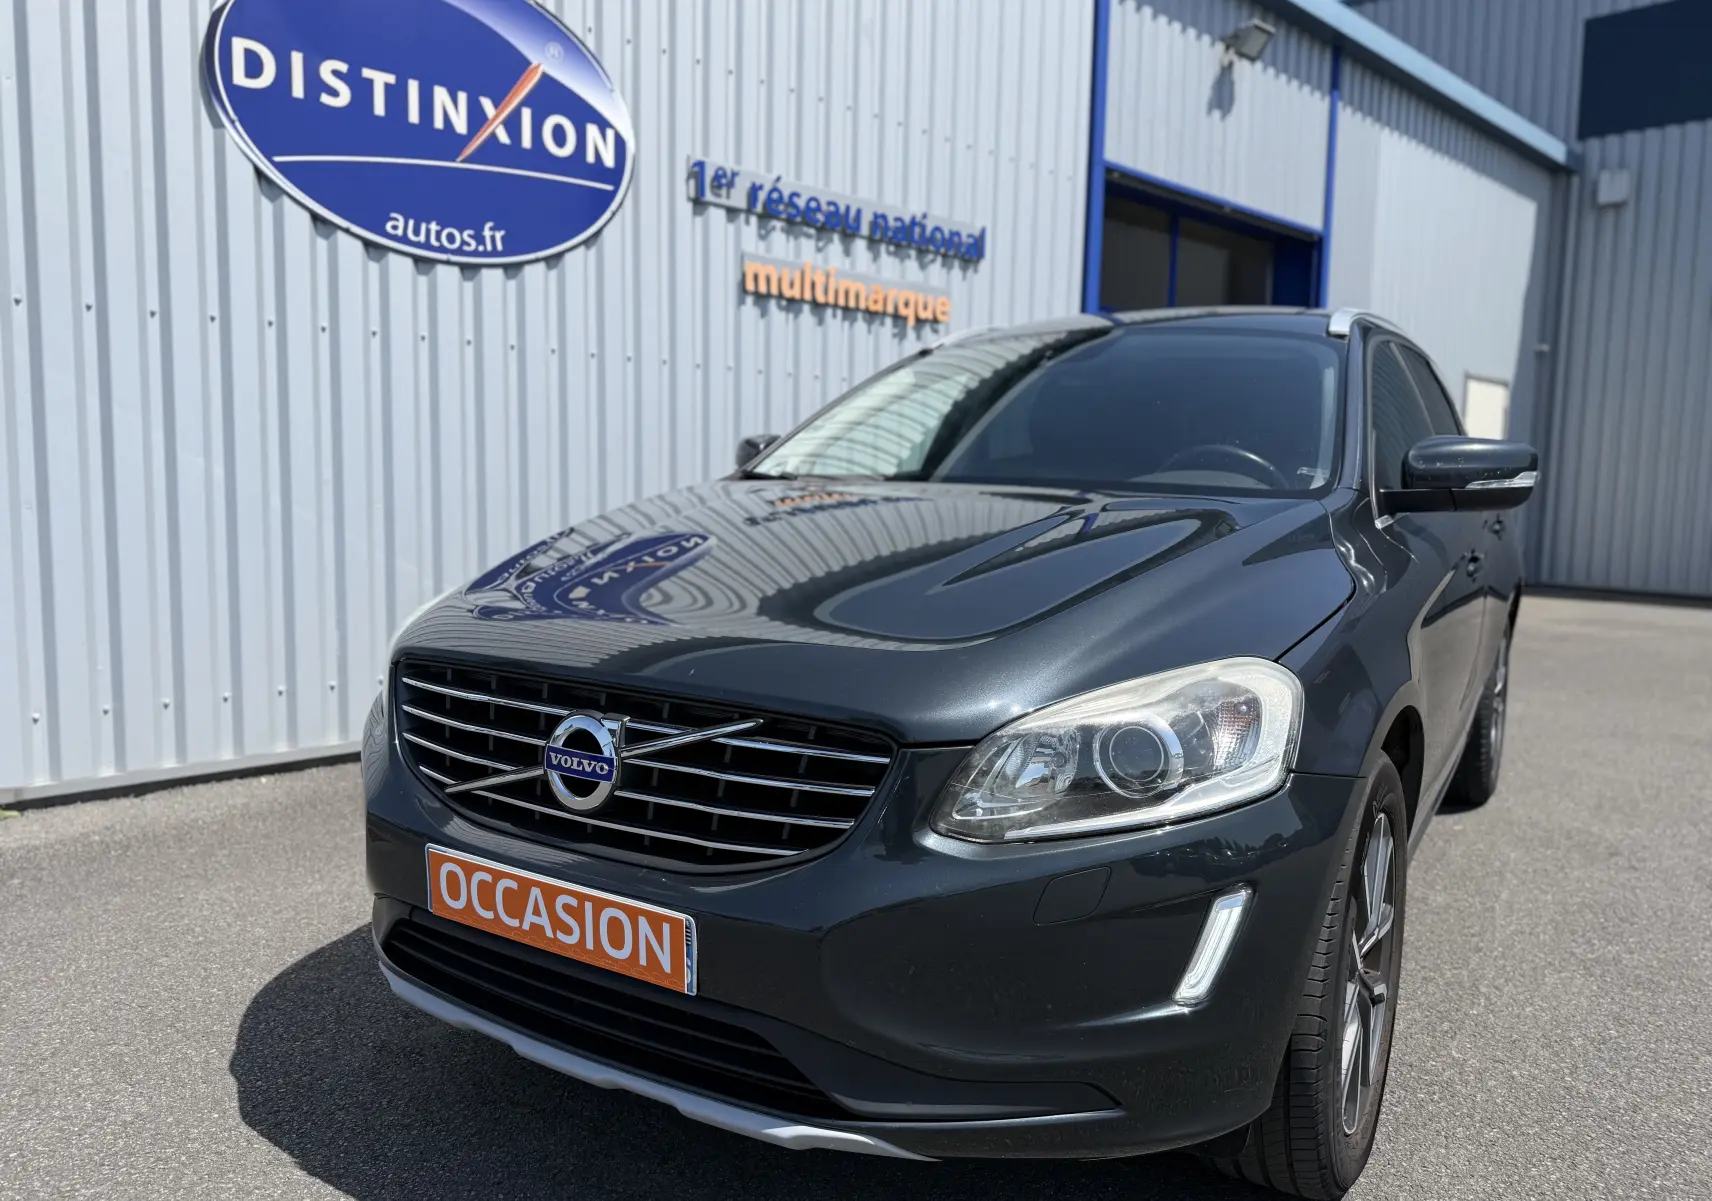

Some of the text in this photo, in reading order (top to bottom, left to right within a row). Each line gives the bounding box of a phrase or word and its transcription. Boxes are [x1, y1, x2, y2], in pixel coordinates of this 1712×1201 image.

[231, 36, 616, 169] DISTINXION
[385, 212, 507, 253] autos.fr
[690, 160, 987, 260] 1er réseau national
[743, 260, 951, 327] multimarque
[549, 752, 609, 775] VOLVO
[439, 861, 672, 974] OCCASION
